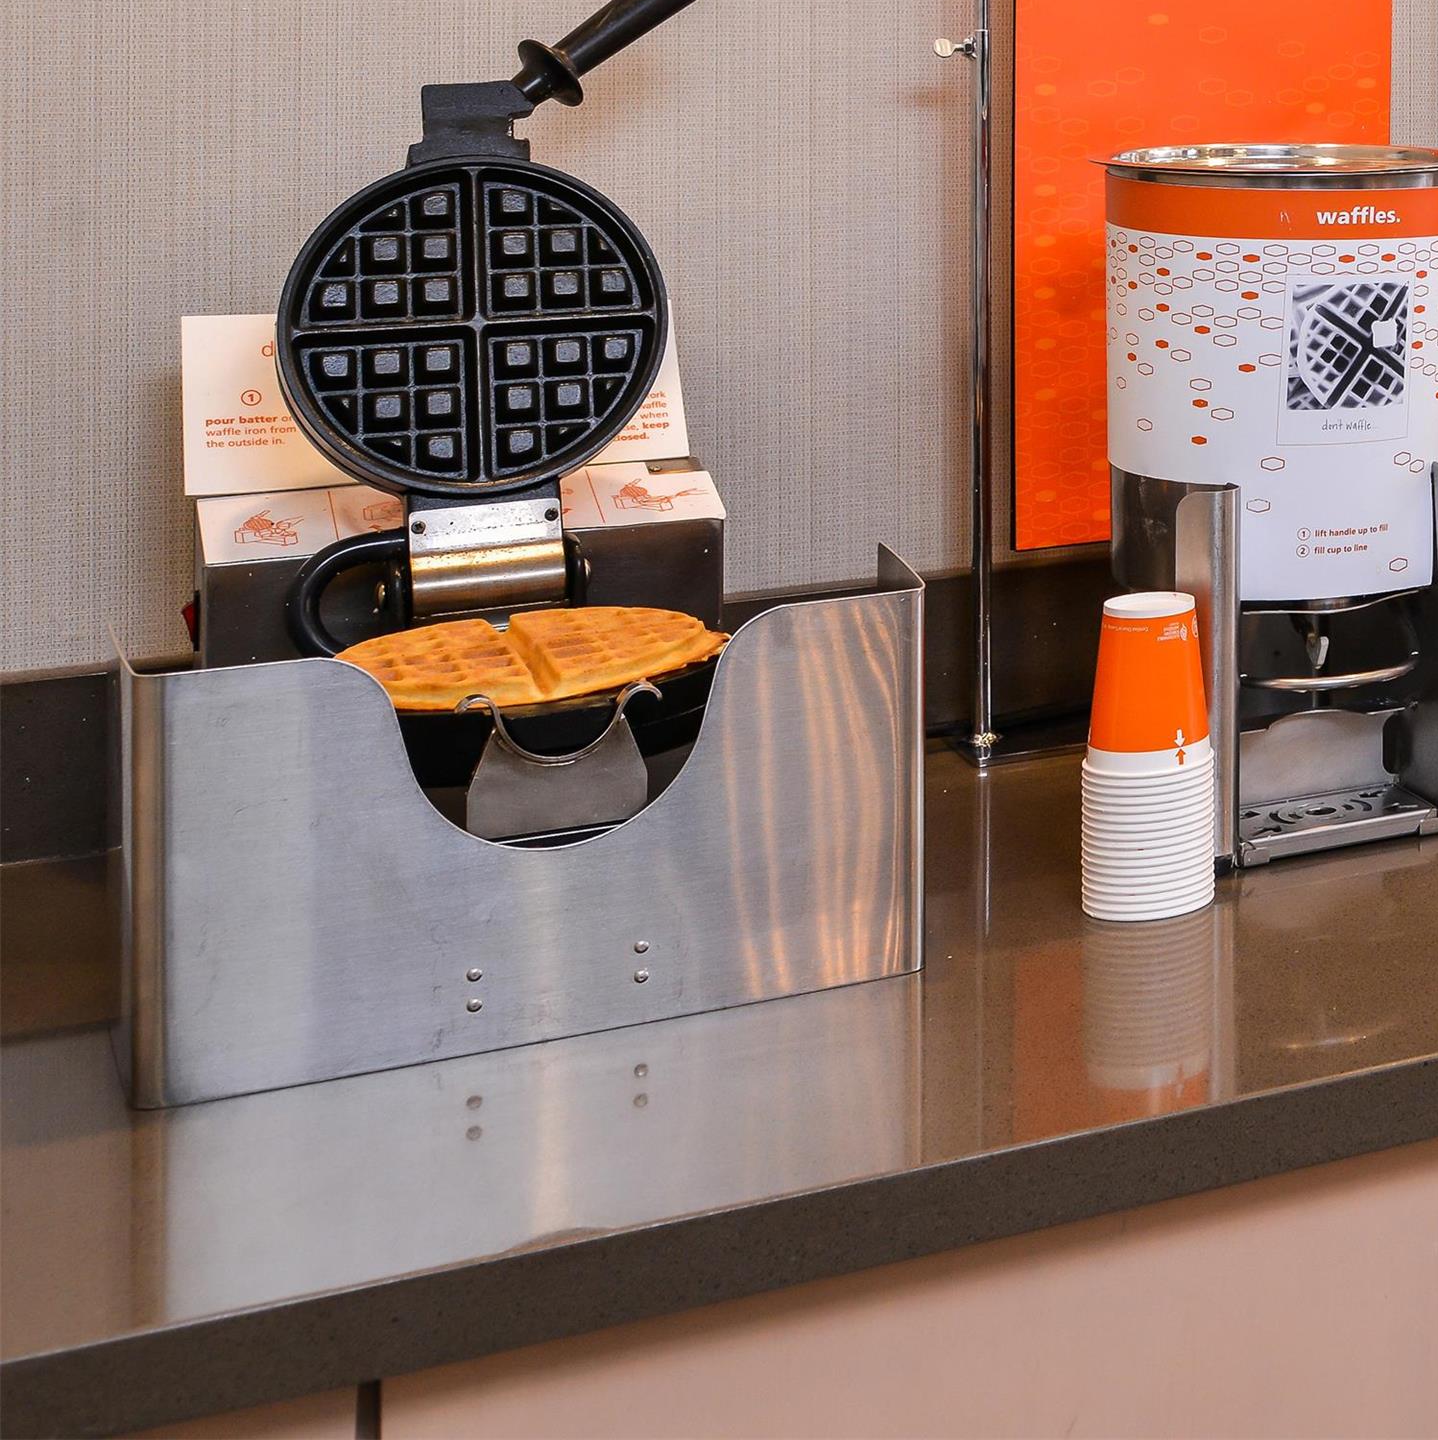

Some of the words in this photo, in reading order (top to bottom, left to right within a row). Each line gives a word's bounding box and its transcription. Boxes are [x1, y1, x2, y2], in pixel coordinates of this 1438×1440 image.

[1316, 206, 1401, 225] waffles.
[647, 391, 666, 399] ork
[205, 417, 236, 427] pour
[239, 415, 278, 424] batter
[640, 411, 668, 420] when
[206, 426, 240, 436] waffle
[245, 426, 267, 435] iron
[270, 425, 297, 434] from
[642, 421, 670, 430] keep
[206, 439, 224, 448] the
[228, 437, 269, 447] outside
[1314, 529, 1327, 538] lift
[1329, 527, 1356, 537] handle
[1379, 523, 1389, 532] fill
[1314, 546, 1325, 554] fill
[1327, 547, 1342, 555] cup
[1354, 544, 1368, 552] line
